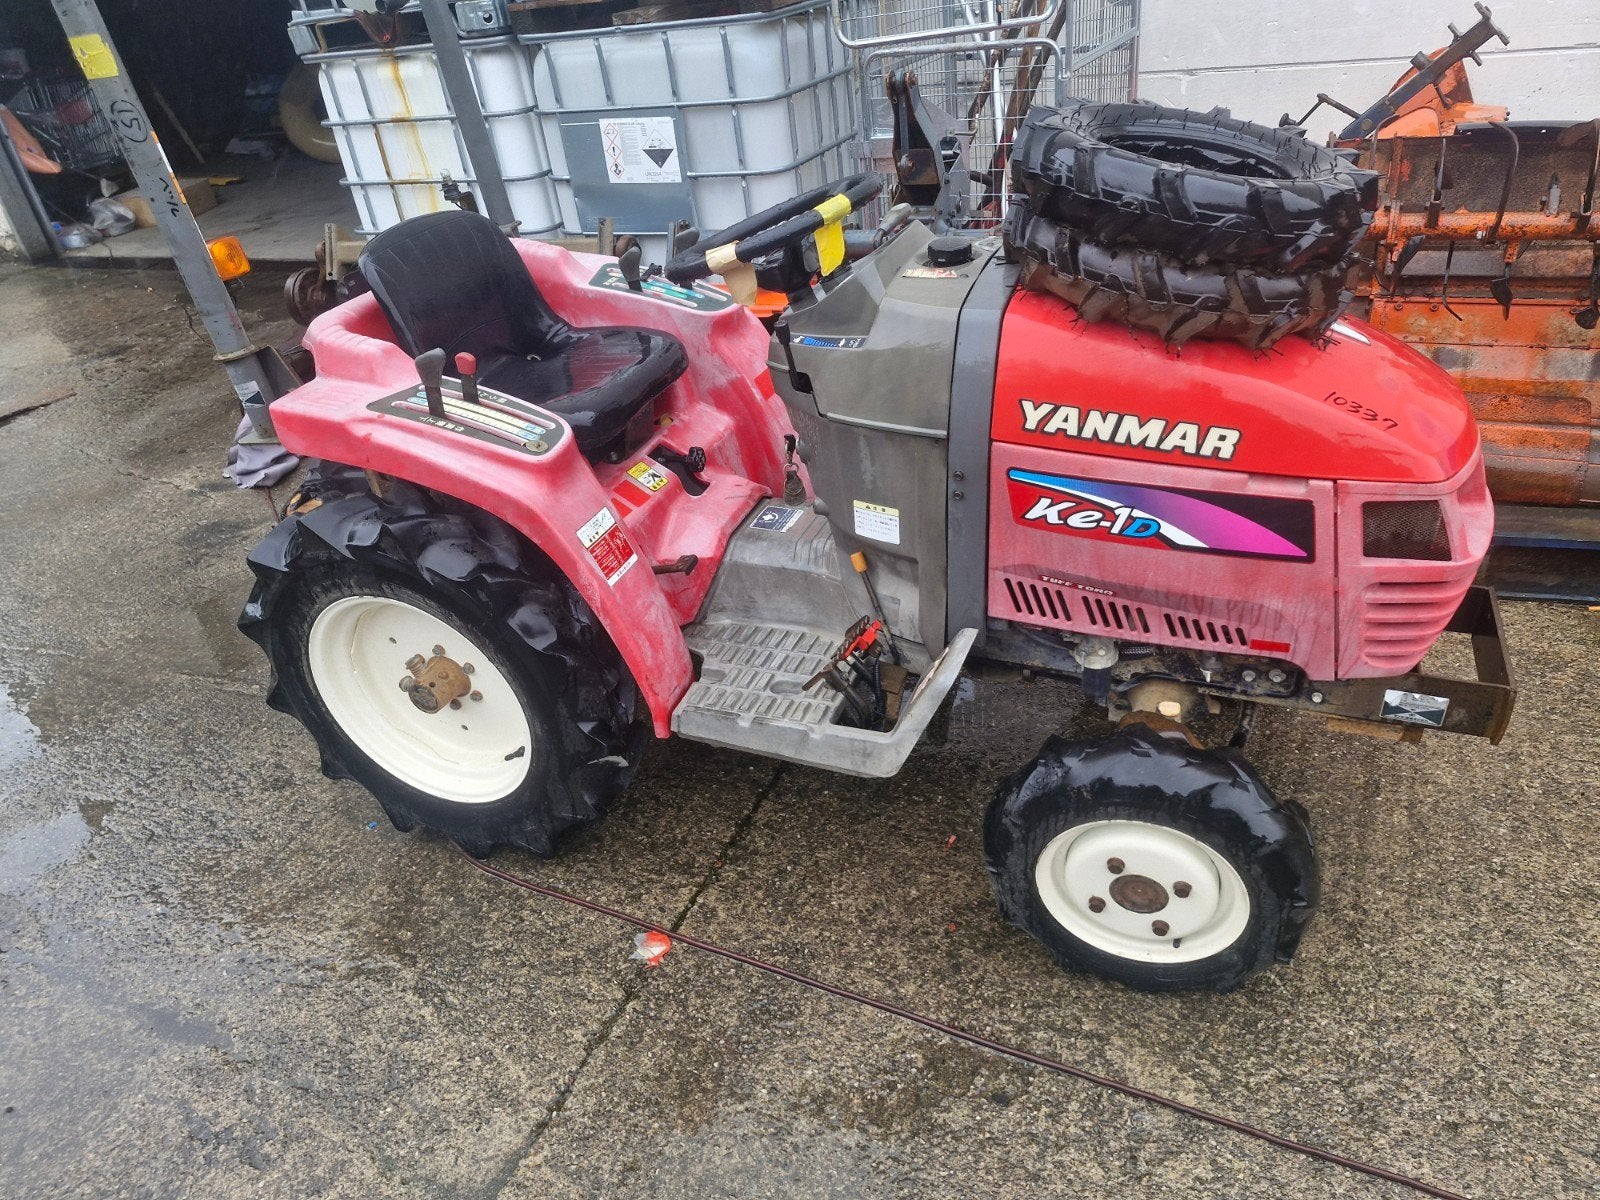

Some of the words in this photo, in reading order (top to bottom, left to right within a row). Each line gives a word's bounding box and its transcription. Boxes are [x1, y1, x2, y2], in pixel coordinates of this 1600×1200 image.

[1020, 399, 1242, 460] YANMAR
[1323, 391, 1399, 432] 10337
[1023, 497, 1161, 538] Ke-1D
